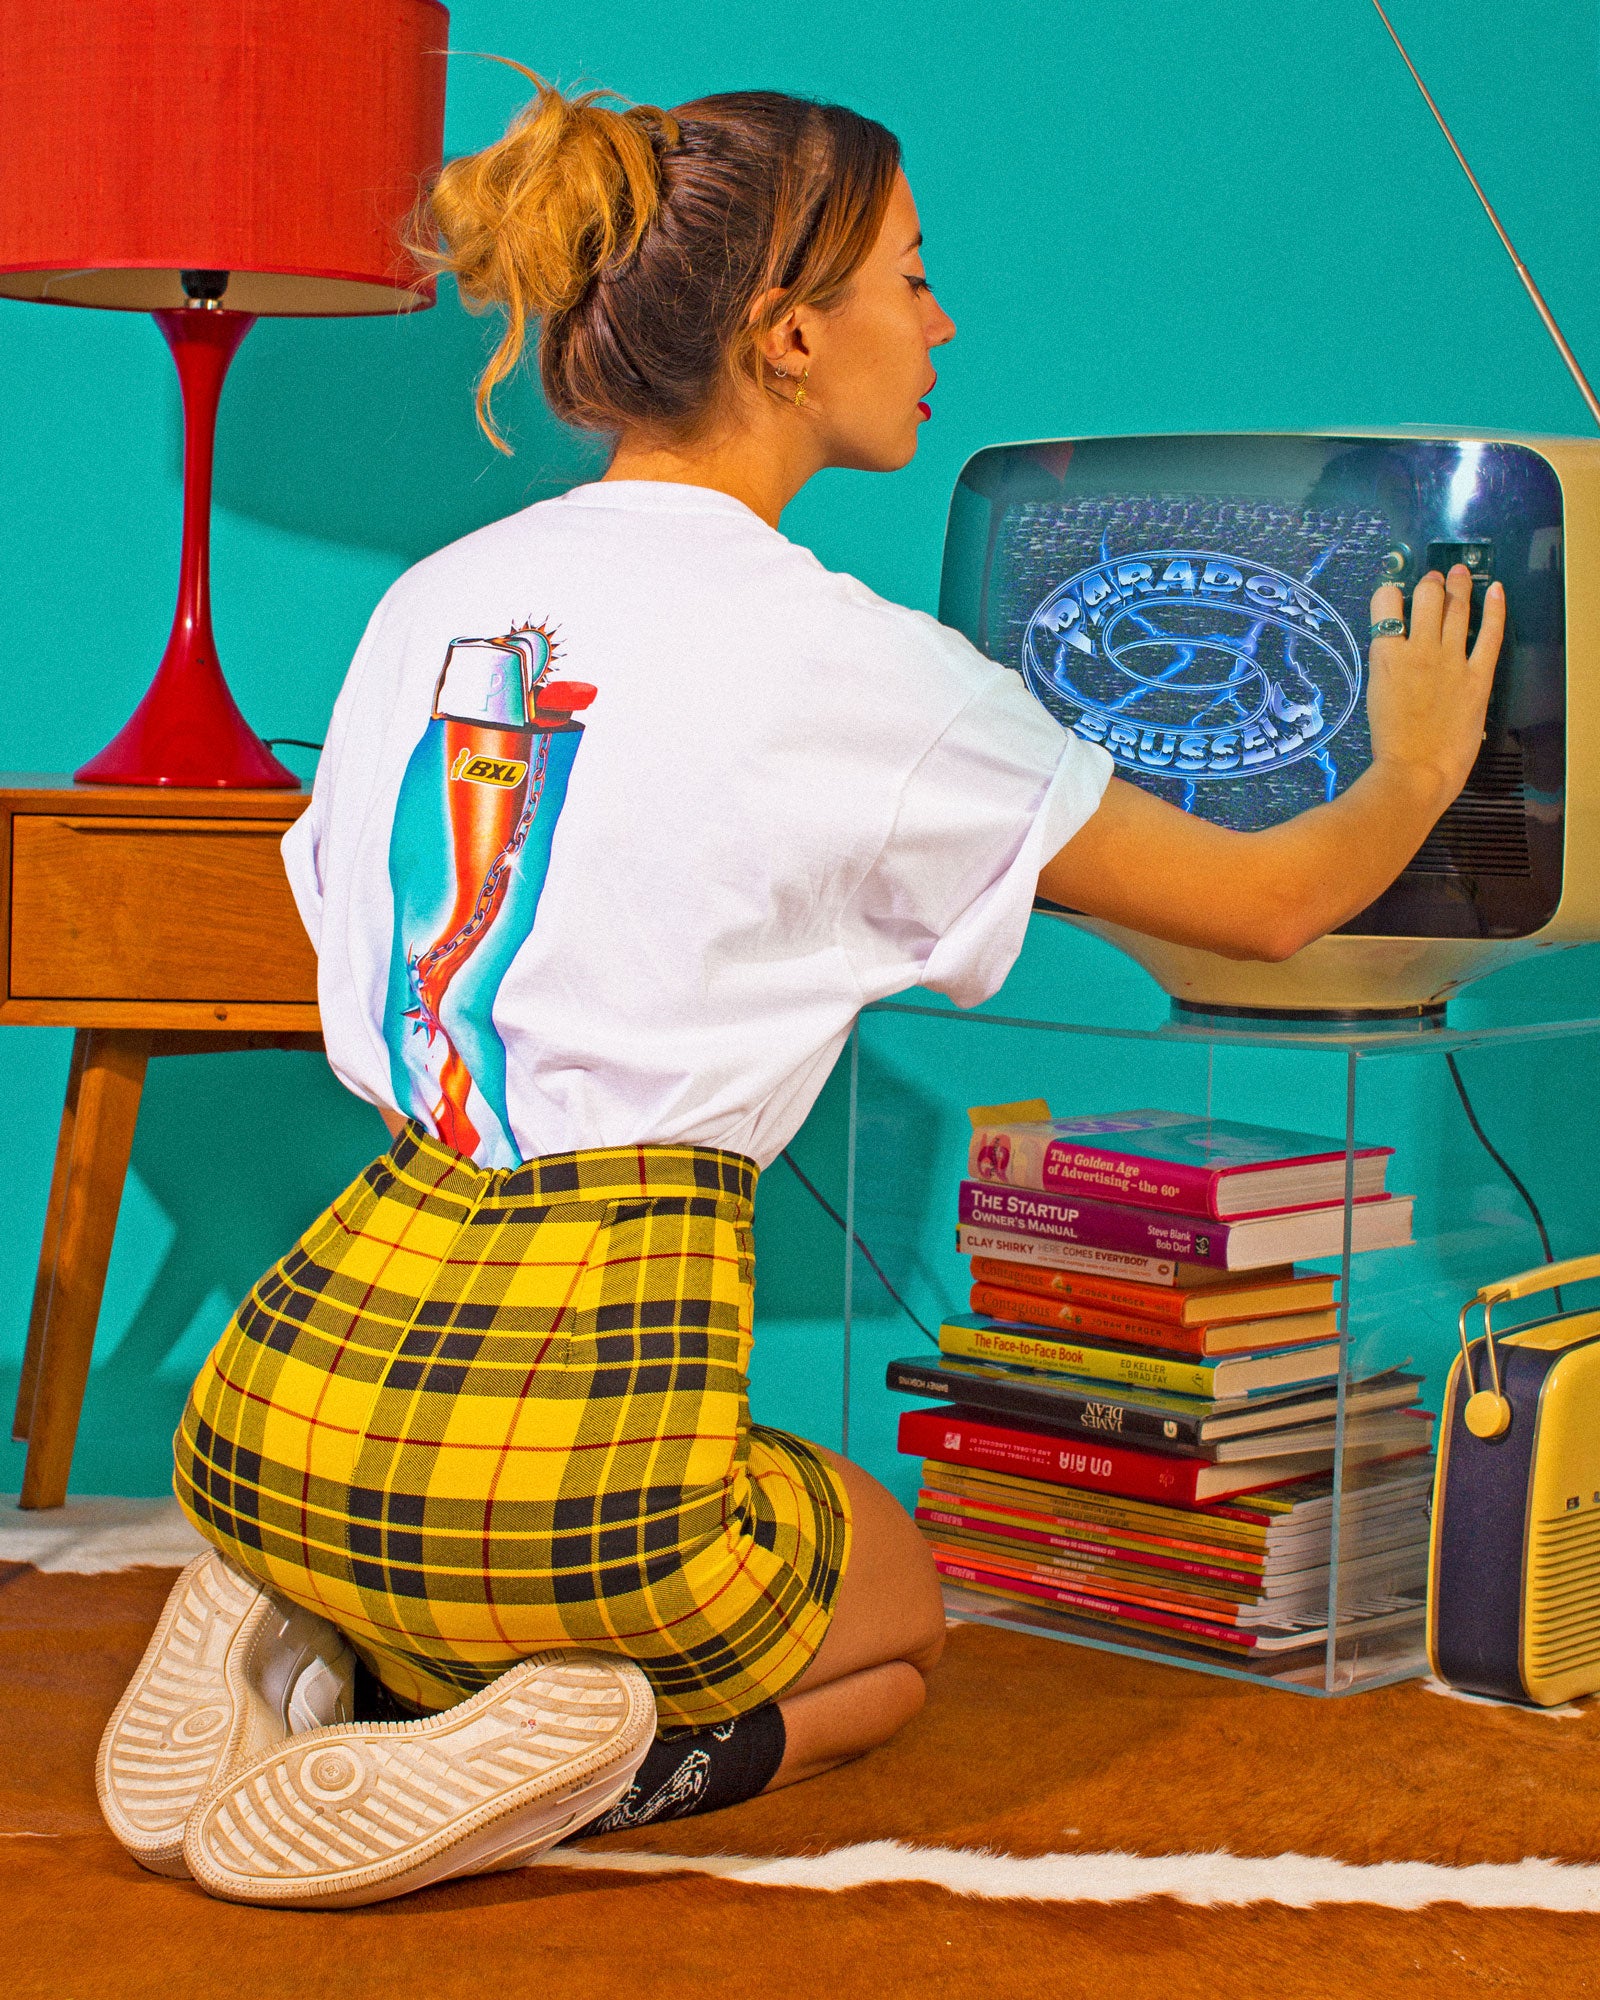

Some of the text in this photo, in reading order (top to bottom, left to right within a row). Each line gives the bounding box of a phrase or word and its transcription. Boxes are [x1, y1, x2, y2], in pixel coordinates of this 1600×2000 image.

[1042, 560, 1335, 657] PARADOX
[1074, 681, 1325, 771] BRUSSELS
[466, 760, 517, 782] BXL
[1047, 1164, 1060, 1176] of
[1050, 1149, 1140, 1178] The Golden Age
[971, 1189, 1080, 1222] THE STARTUP
[972, 1209, 1078, 1238] OWNER'S MANUAL
[1147, 1225, 1191, 1242] Steve Blank
[967, 1235, 1034, 1254] CLAY SHIRKY
[1156, 1238, 1192, 1253] Bob Dorf
[1062, 1246, 1094, 1260] COMES
[1094, 1252, 1149, 1267] EVERYBODY
[980, 1258, 1044, 1286] Contagious
[981, 1291, 1050, 1317] Contagious
[1079, 1287, 1108, 1301] JONAH
[1111, 1294, 1145, 1308] BERGER
[1089, 1317, 1162, 1338] JONAH BERGER
[974, 1333, 1084, 1364] The Face-to-Face Book
[1120, 1359, 1166, 1374] ED KELLER
[1128, 1370, 1151, 1382] BRAD
[1152, 1373, 1168, 1384] FAY
[1085, 1402, 1124, 1421] DEAN
[1081, 1414, 1123, 1433] JAMES
[1059, 1451, 1087, 1473] AIR
